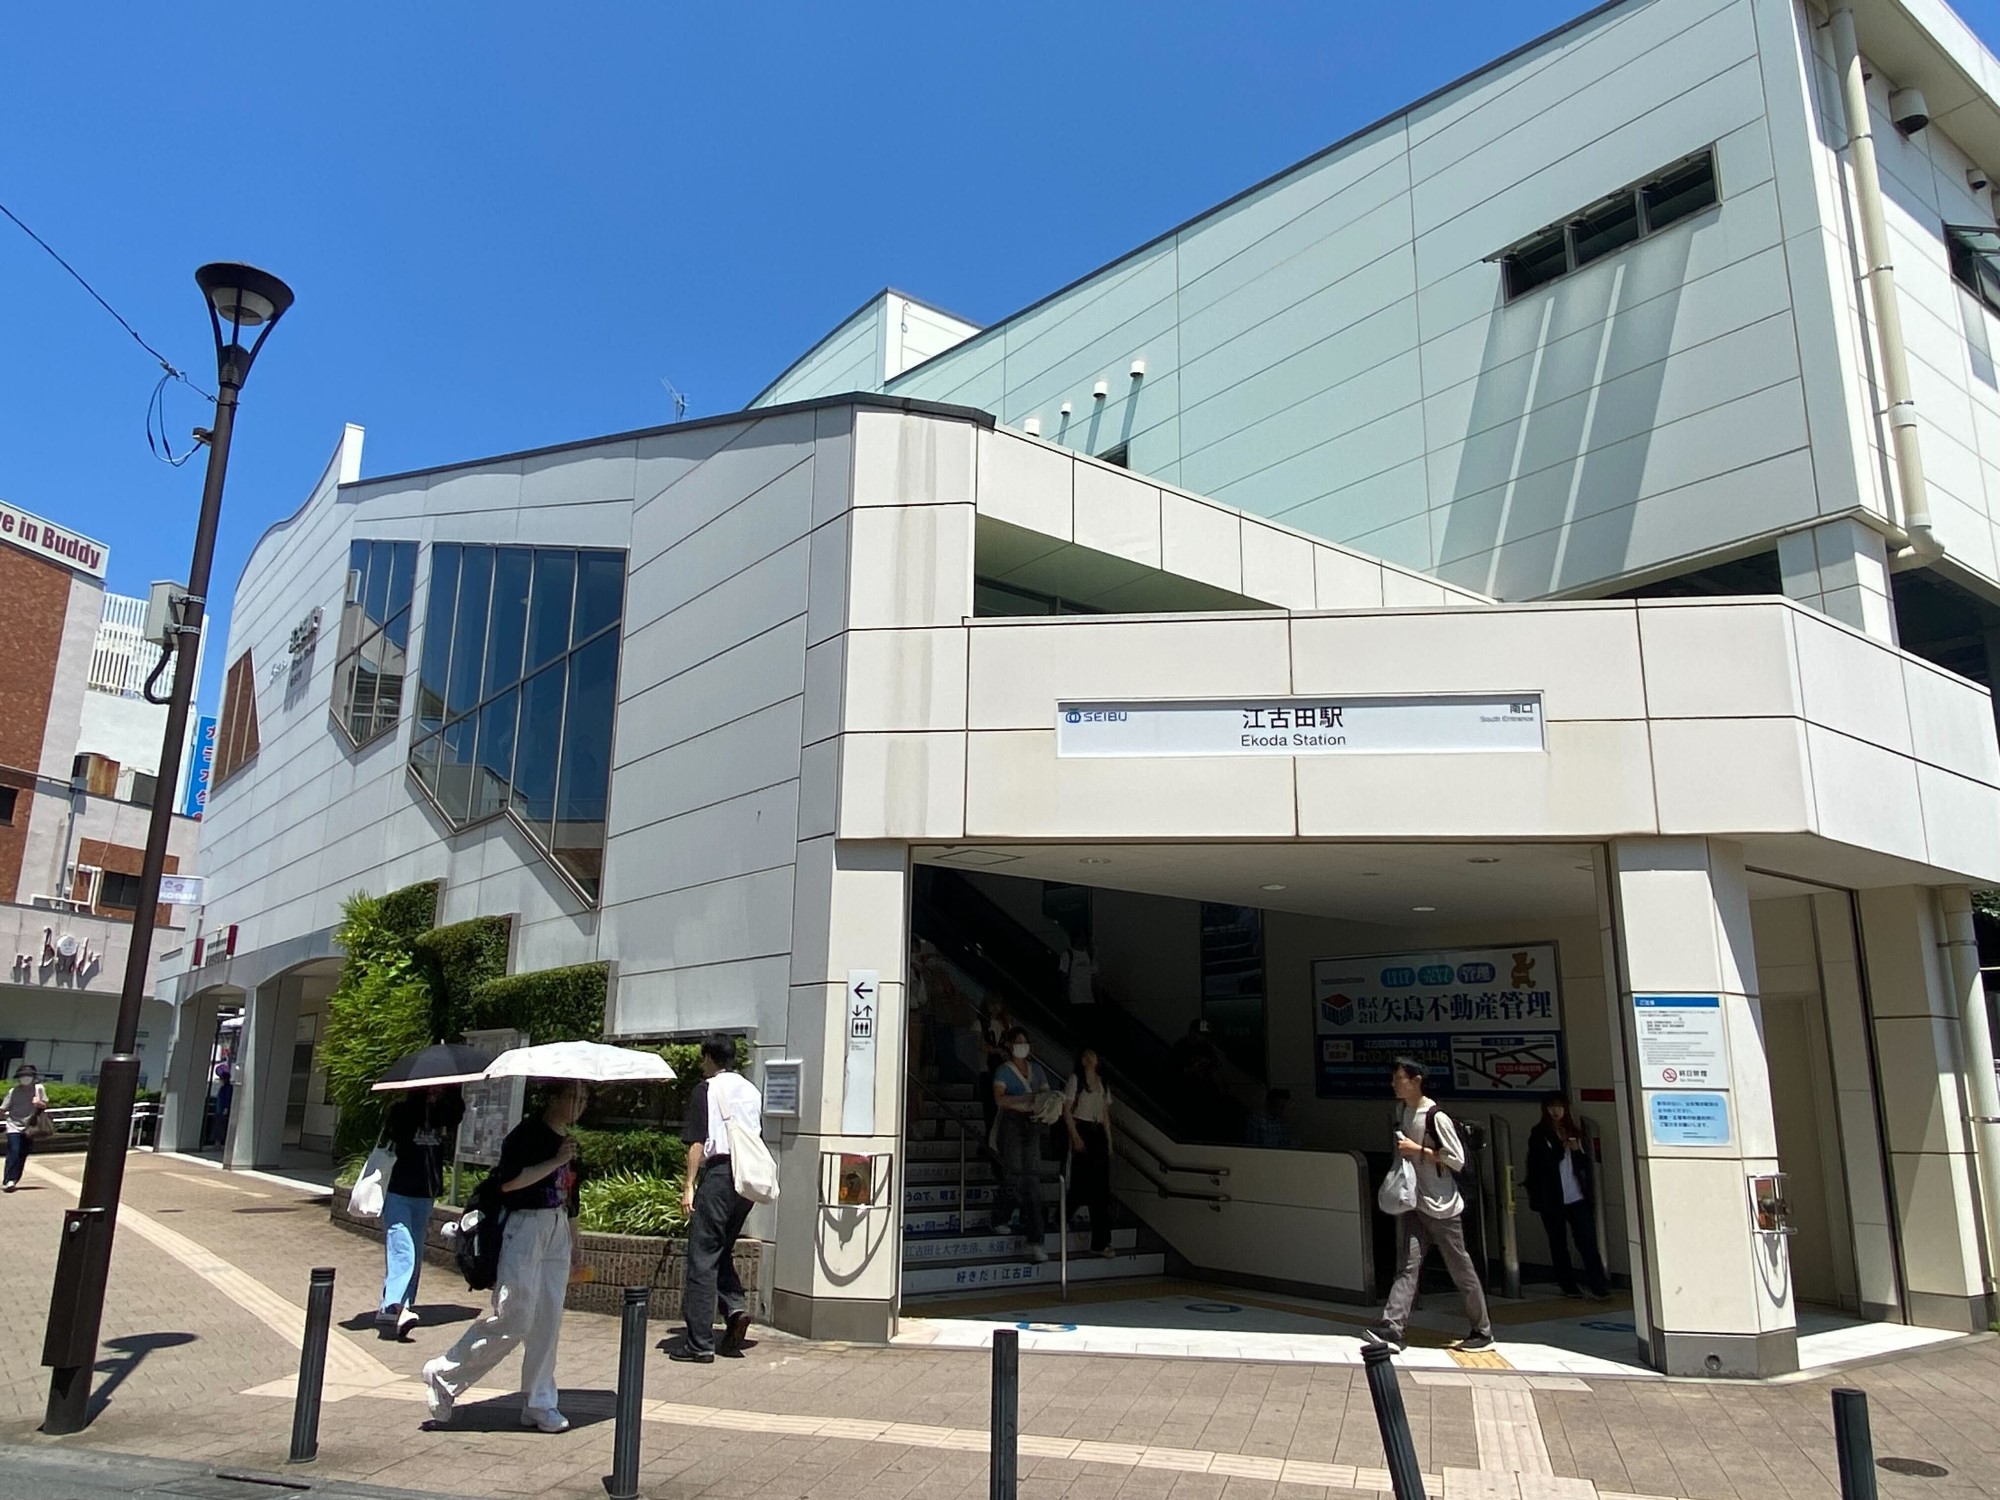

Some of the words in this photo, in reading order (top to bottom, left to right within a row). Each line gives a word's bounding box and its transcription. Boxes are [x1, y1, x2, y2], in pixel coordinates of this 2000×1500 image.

[0, 511, 15, 533] e
[18, 516, 38, 543] in
[41, 526, 101, 570] Buddy
[1083, 711, 1128, 722] SEIBU
[1242, 706, 1344, 729] 江古田駅
[1241, 734, 1288, 747] Ekoda
[1293, 733, 1347, 746] Station
[1381, 991, 1553, 1022] 矢島不動産管理
[955, 1266, 1041, 1284] 好きだ！江古田！
